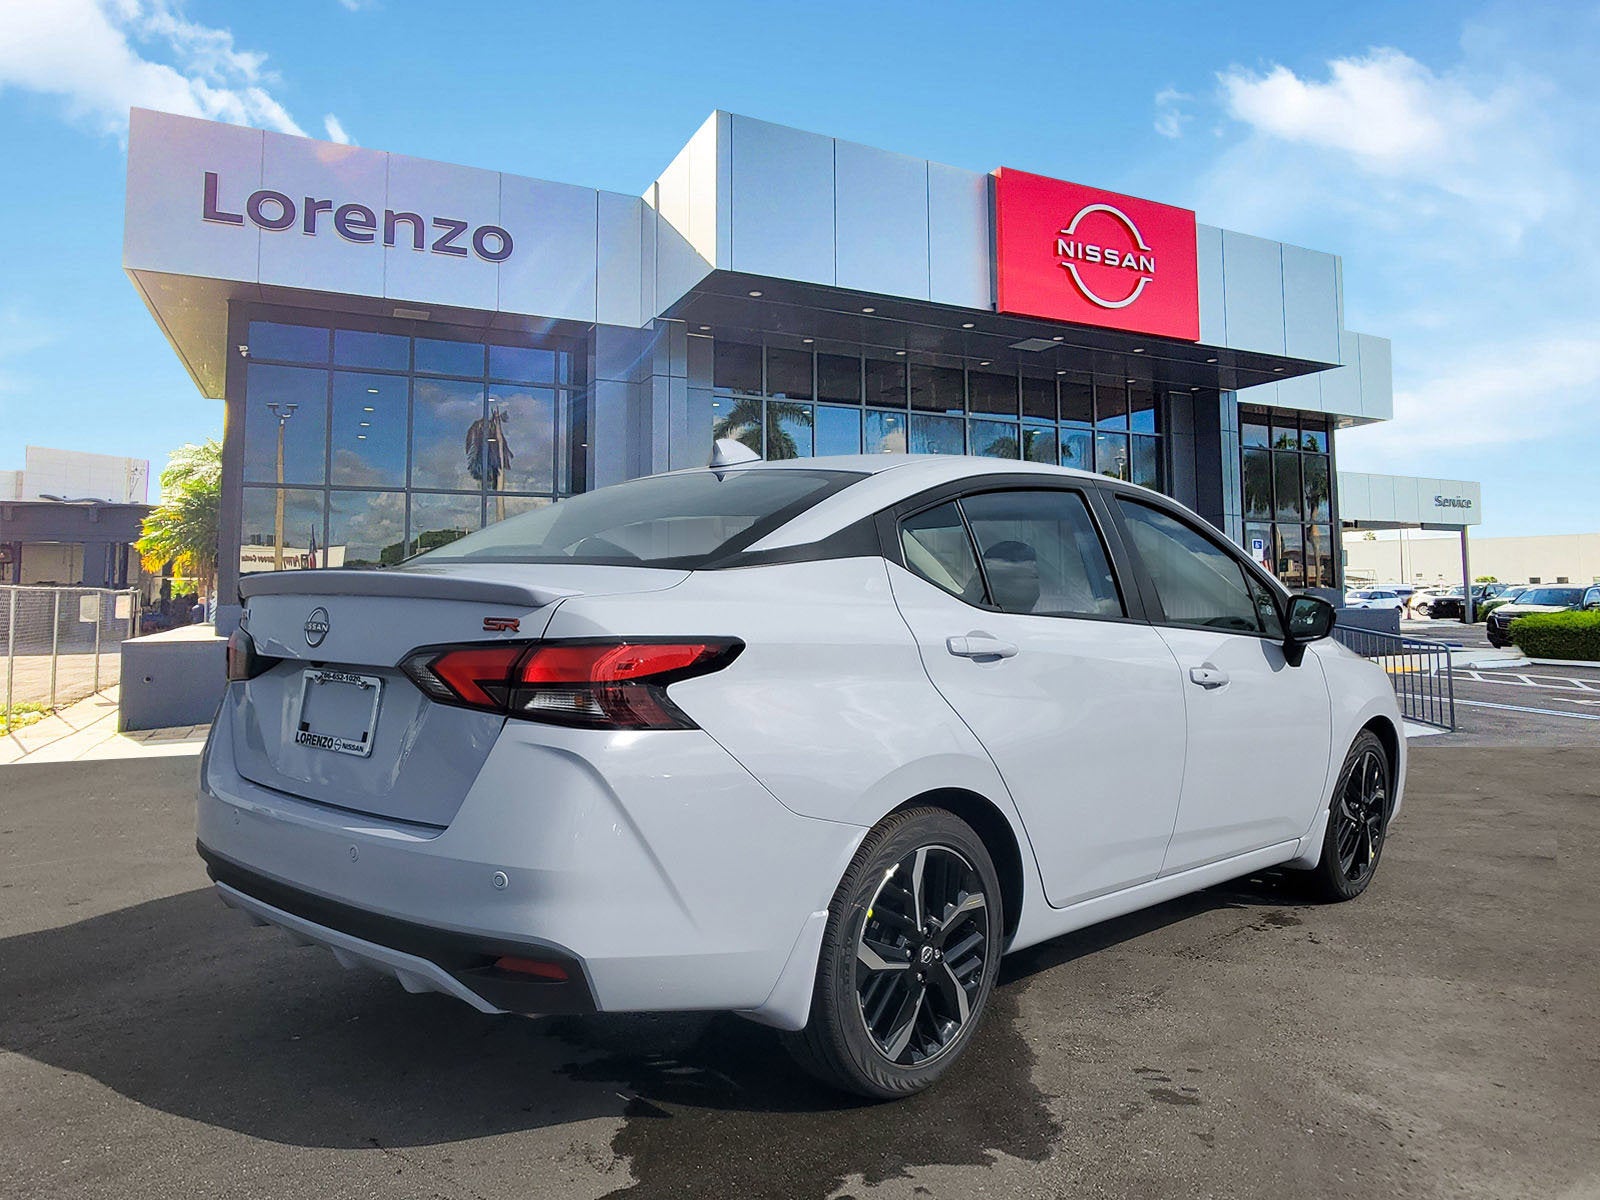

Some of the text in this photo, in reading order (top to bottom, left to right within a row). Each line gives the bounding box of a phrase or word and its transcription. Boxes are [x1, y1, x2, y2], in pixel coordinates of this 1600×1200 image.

[202, 171, 514, 262] Lorenzo
[1056, 238, 1155, 273] NISSAN
[1434, 495, 1472, 509] Service
[483, 617, 520, 632] SR
[295, 731, 364, 753] LORENZO NISSAN
